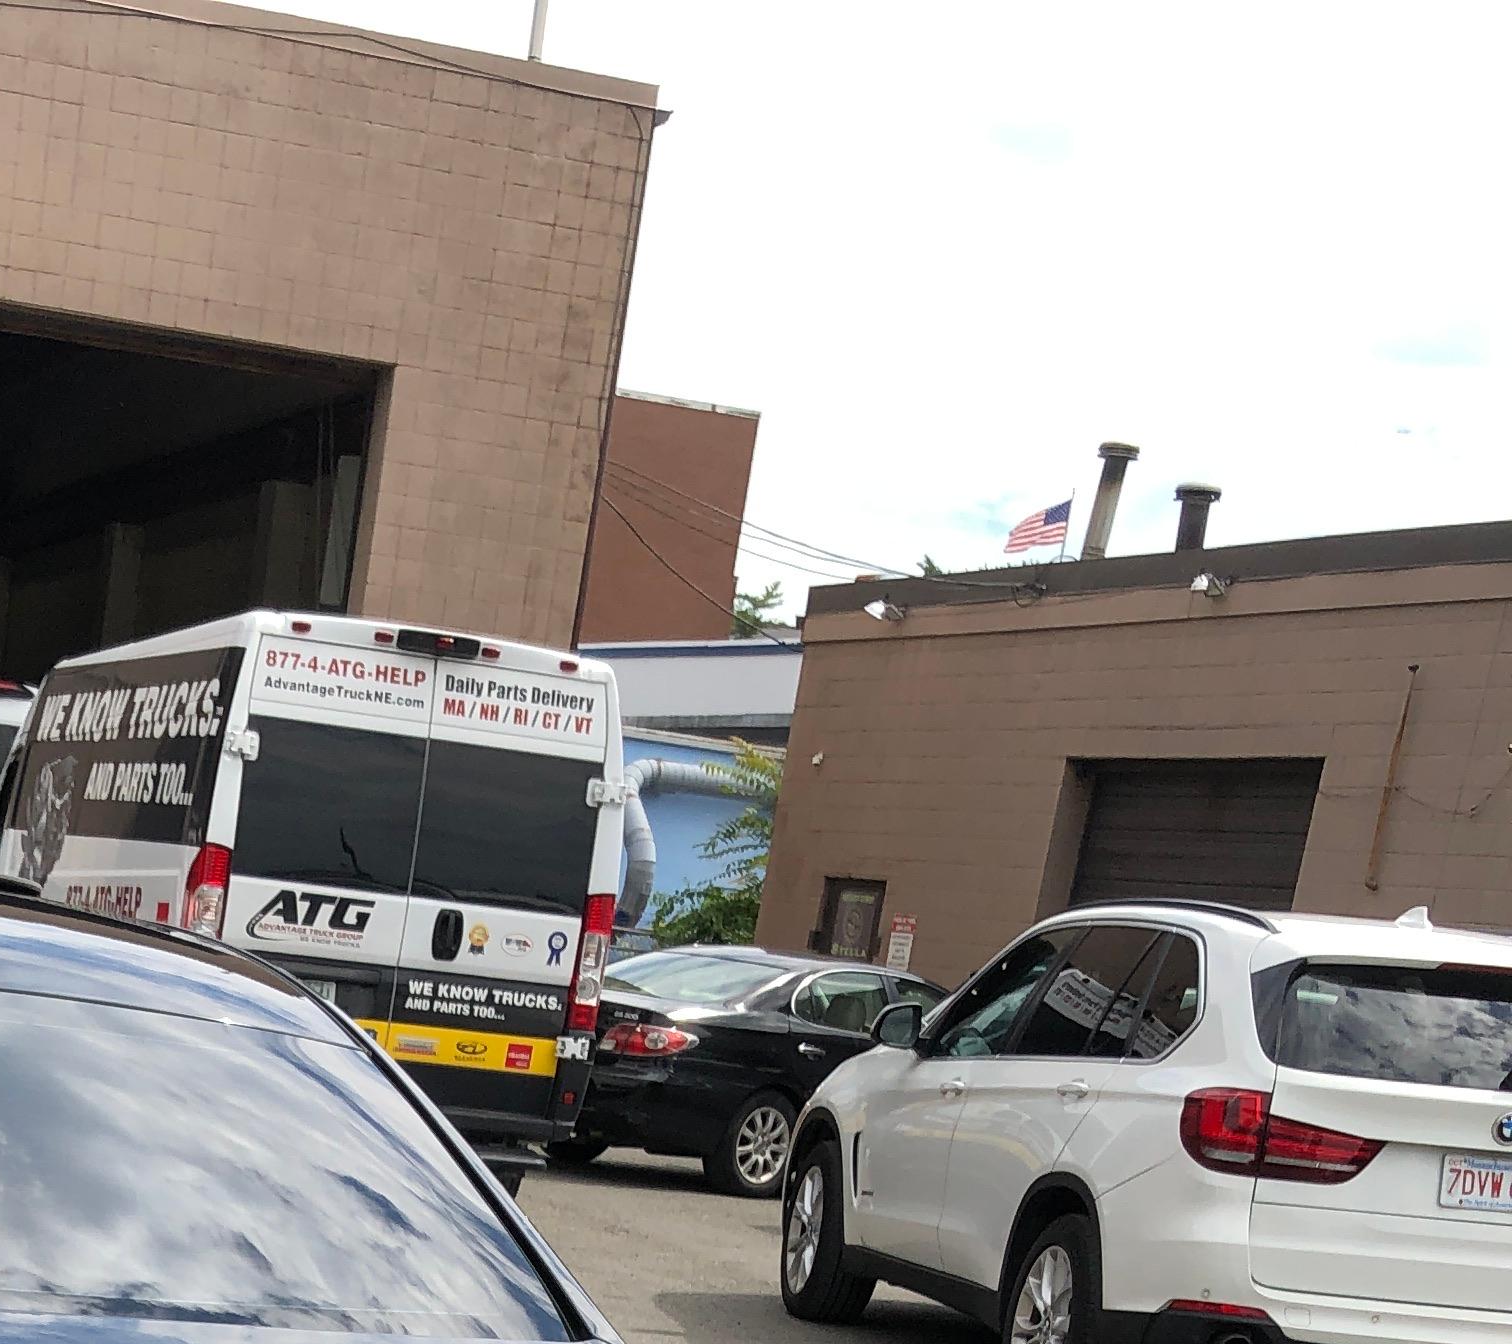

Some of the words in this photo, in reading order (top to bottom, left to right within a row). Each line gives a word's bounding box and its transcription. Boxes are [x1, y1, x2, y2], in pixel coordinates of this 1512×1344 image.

[265, 650, 426, 688] 877-4-ATG-HELP
[264, 676, 424, 709] AdvantageTruckNE.com
[445, 674, 484, 698] Daily
[488, 680, 527, 703] Parts
[531, 686, 595, 713] Delivery
[37, 694, 72, 742] WE
[65, 688, 132, 742] KNOW
[443, 697, 466, 718] MA
[479, 703, 500, 722] NH
[513, 707, 529, 726] RI
[542, 711, 561, 730] CT
[574, 715, 593, 735] VT
[84, 762, 115, 800] AND
[111, 762, 158, 803] PARTS
[247, 889, 376, 933] ATG
[405, 996, 431, 1011] AND
[433, 1000, 471, 1017] PARTS
[409, 979, 434, 996] WE
[438, 984, 489, 1003] KNOW
[1448, 1168, 1503, 1198] 7DVW
